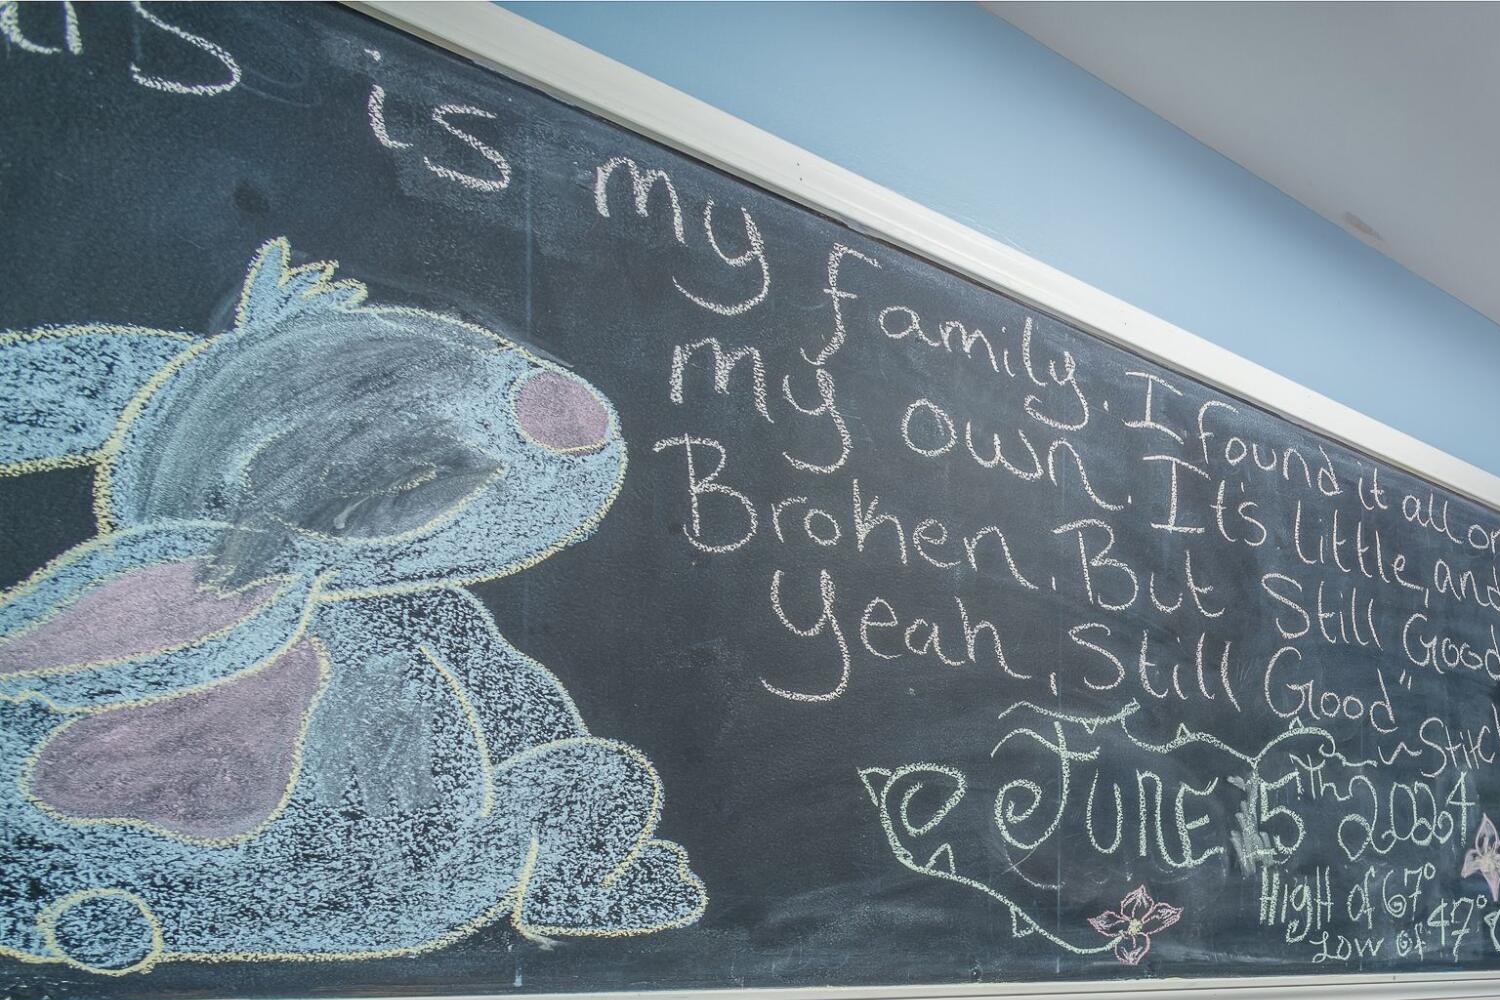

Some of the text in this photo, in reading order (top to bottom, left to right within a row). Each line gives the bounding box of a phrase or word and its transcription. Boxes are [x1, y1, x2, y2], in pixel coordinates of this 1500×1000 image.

[364, 47, 512, 192] is
[596, 156, 770, 316] my
[1122, 371, 1184, 444] I
[1357, 460, 1389, 511] it
[1402, 492, 1463, 544] all
[669, 337, 851, 474] my
[1052, 517, 1226, 618] But
[1260, 572, 1384, 652] Still
[1068, 622, 1241, 714] Still
